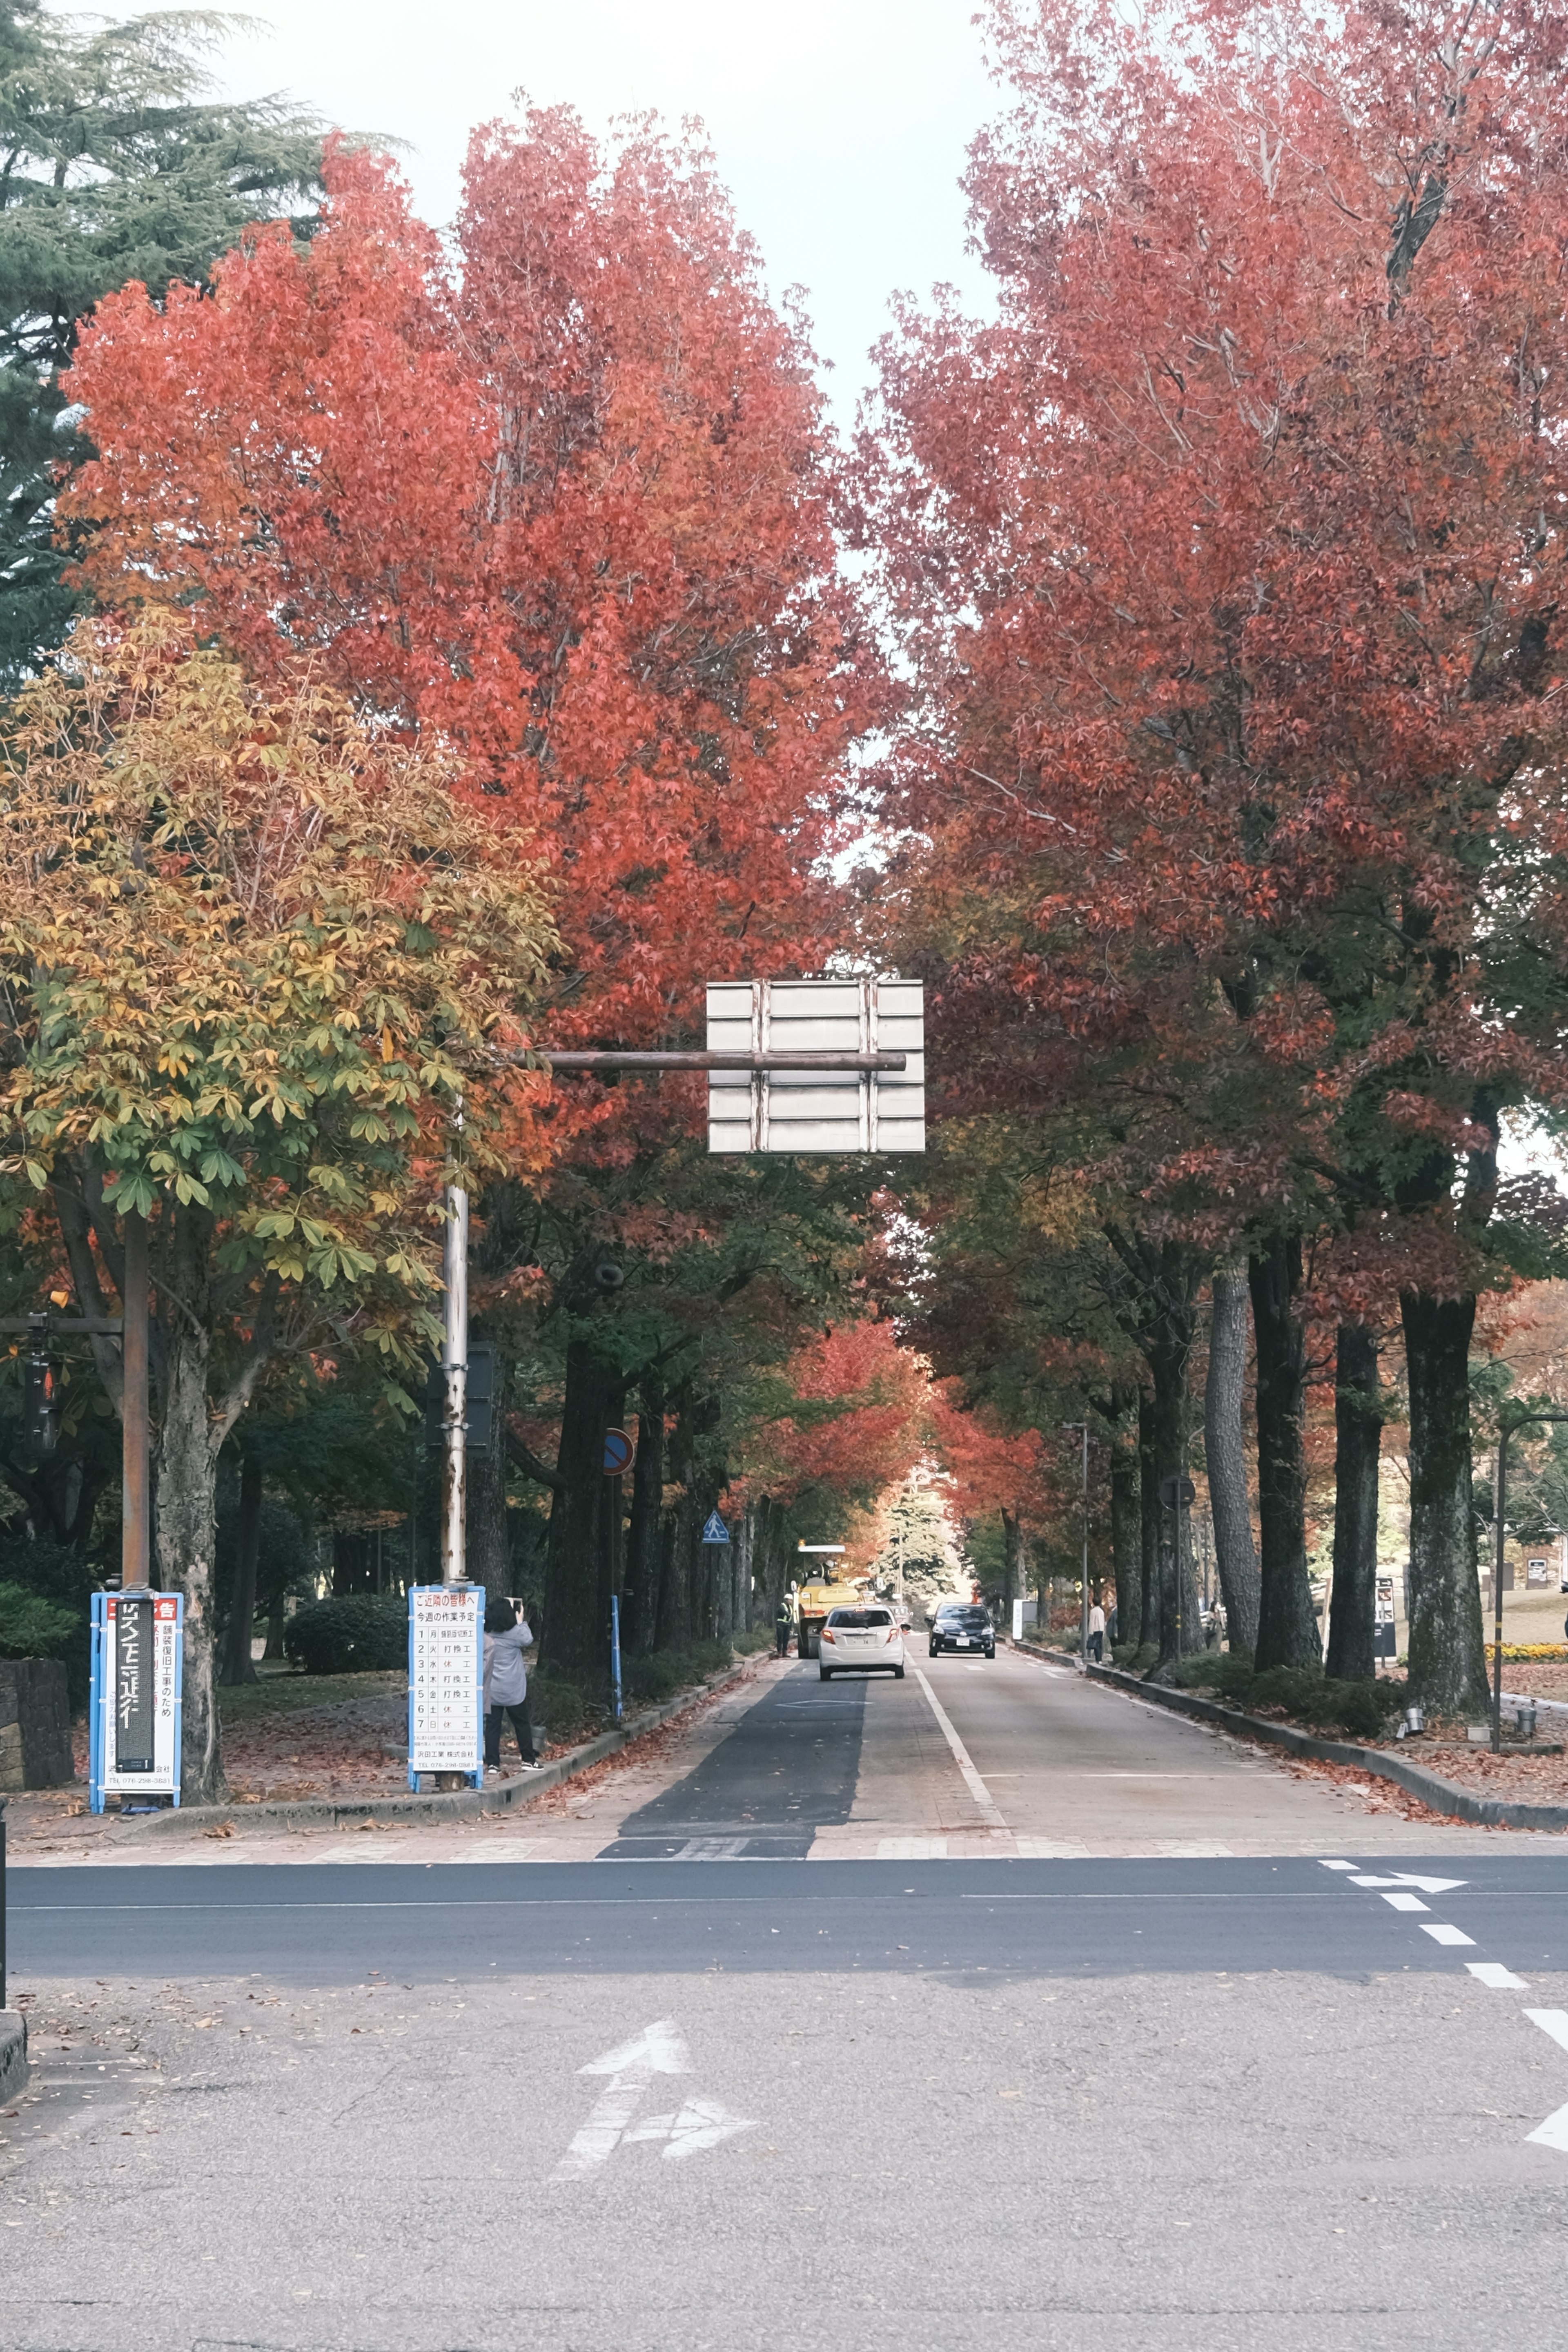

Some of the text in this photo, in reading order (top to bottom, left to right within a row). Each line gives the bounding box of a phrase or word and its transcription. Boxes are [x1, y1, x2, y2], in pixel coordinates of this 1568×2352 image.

[417, 1594, 474, 1607] ご近隣の皆様へ
[417, 1612, 474, 1622] 今週の作業予定
[419, 1630, 423, 1638] 1
[430, 1630, 437, 1638] 月
[418, 1645, 424, 1653] 2
[430, 1645, 437, 1653] 火
[418, 1659, 424, 1668] 3
[430, 1660, 437, 1668] 水
[418, 1690, 424, 1698] 5
[430, 1690, 436, 1699] 金
[418, 1705, 424, 1713] 6
[418, 1719, 424, 1728] 7
